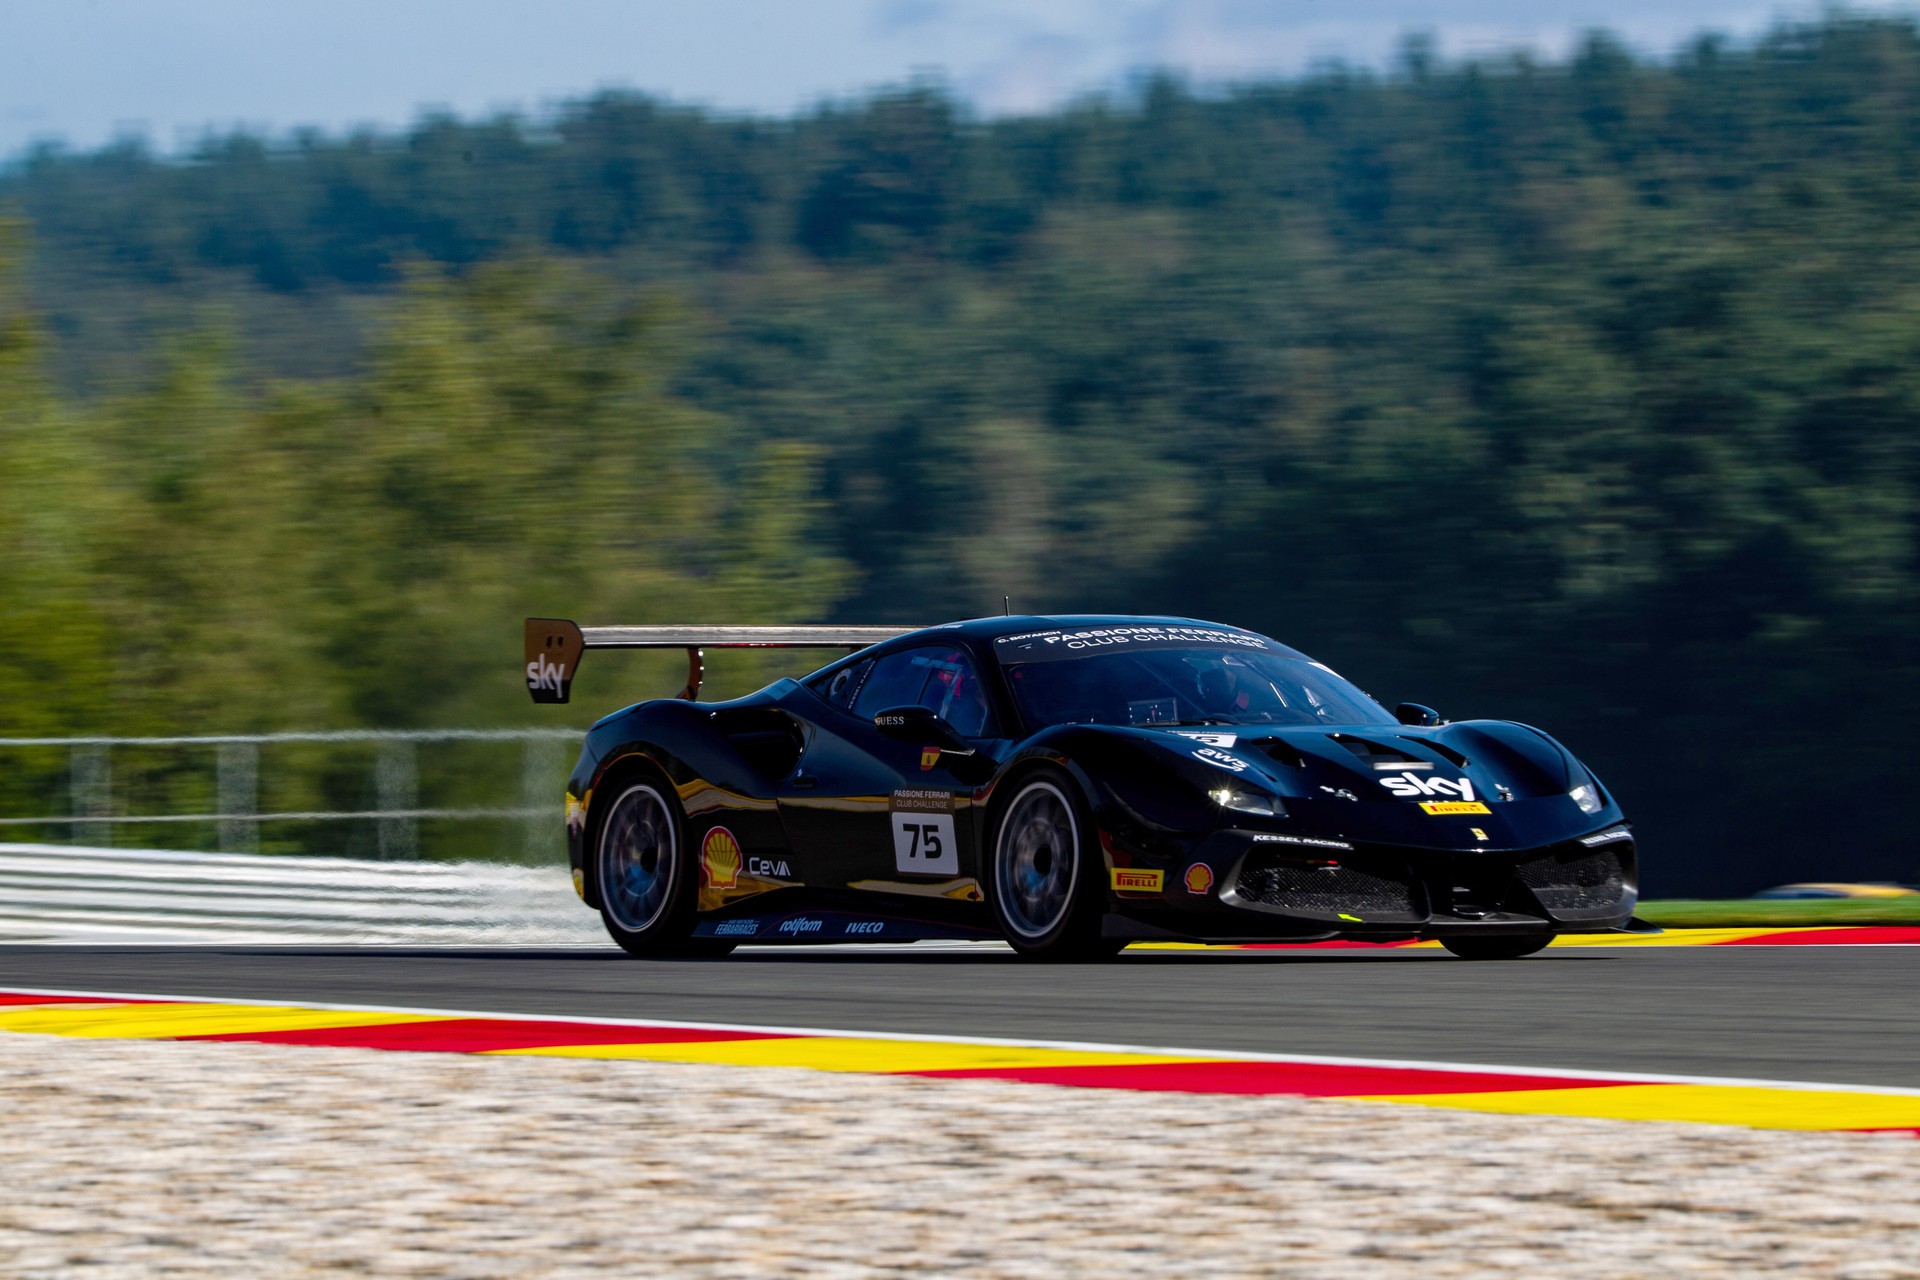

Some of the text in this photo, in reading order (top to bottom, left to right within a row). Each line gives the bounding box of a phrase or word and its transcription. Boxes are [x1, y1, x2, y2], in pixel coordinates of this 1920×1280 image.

[1044, 628, 1265, 644] PASSIONE FERRARI
[1067, 635, 1268, 649] CLUB CHALLENGE
[527, 653, 566, 698] sky
[875, 716, 905, 725] GUESS
[1197, 748, 1250, 768] aws
[1379, 772, 1475, 801] sky
[894, 790, 950, 799] PASSIONE FERRARI
[896, 799, 948, 809] CLUB CHALLENGE
[902, 823, 942, 859] 75
[1253, 834, 1350, 848] KESSEL RACING
[1116, 872, 1158, 887] PIRELLI
[779, 917, 823, 936] rotiform
[845, 922, 884, 934] IVECO
